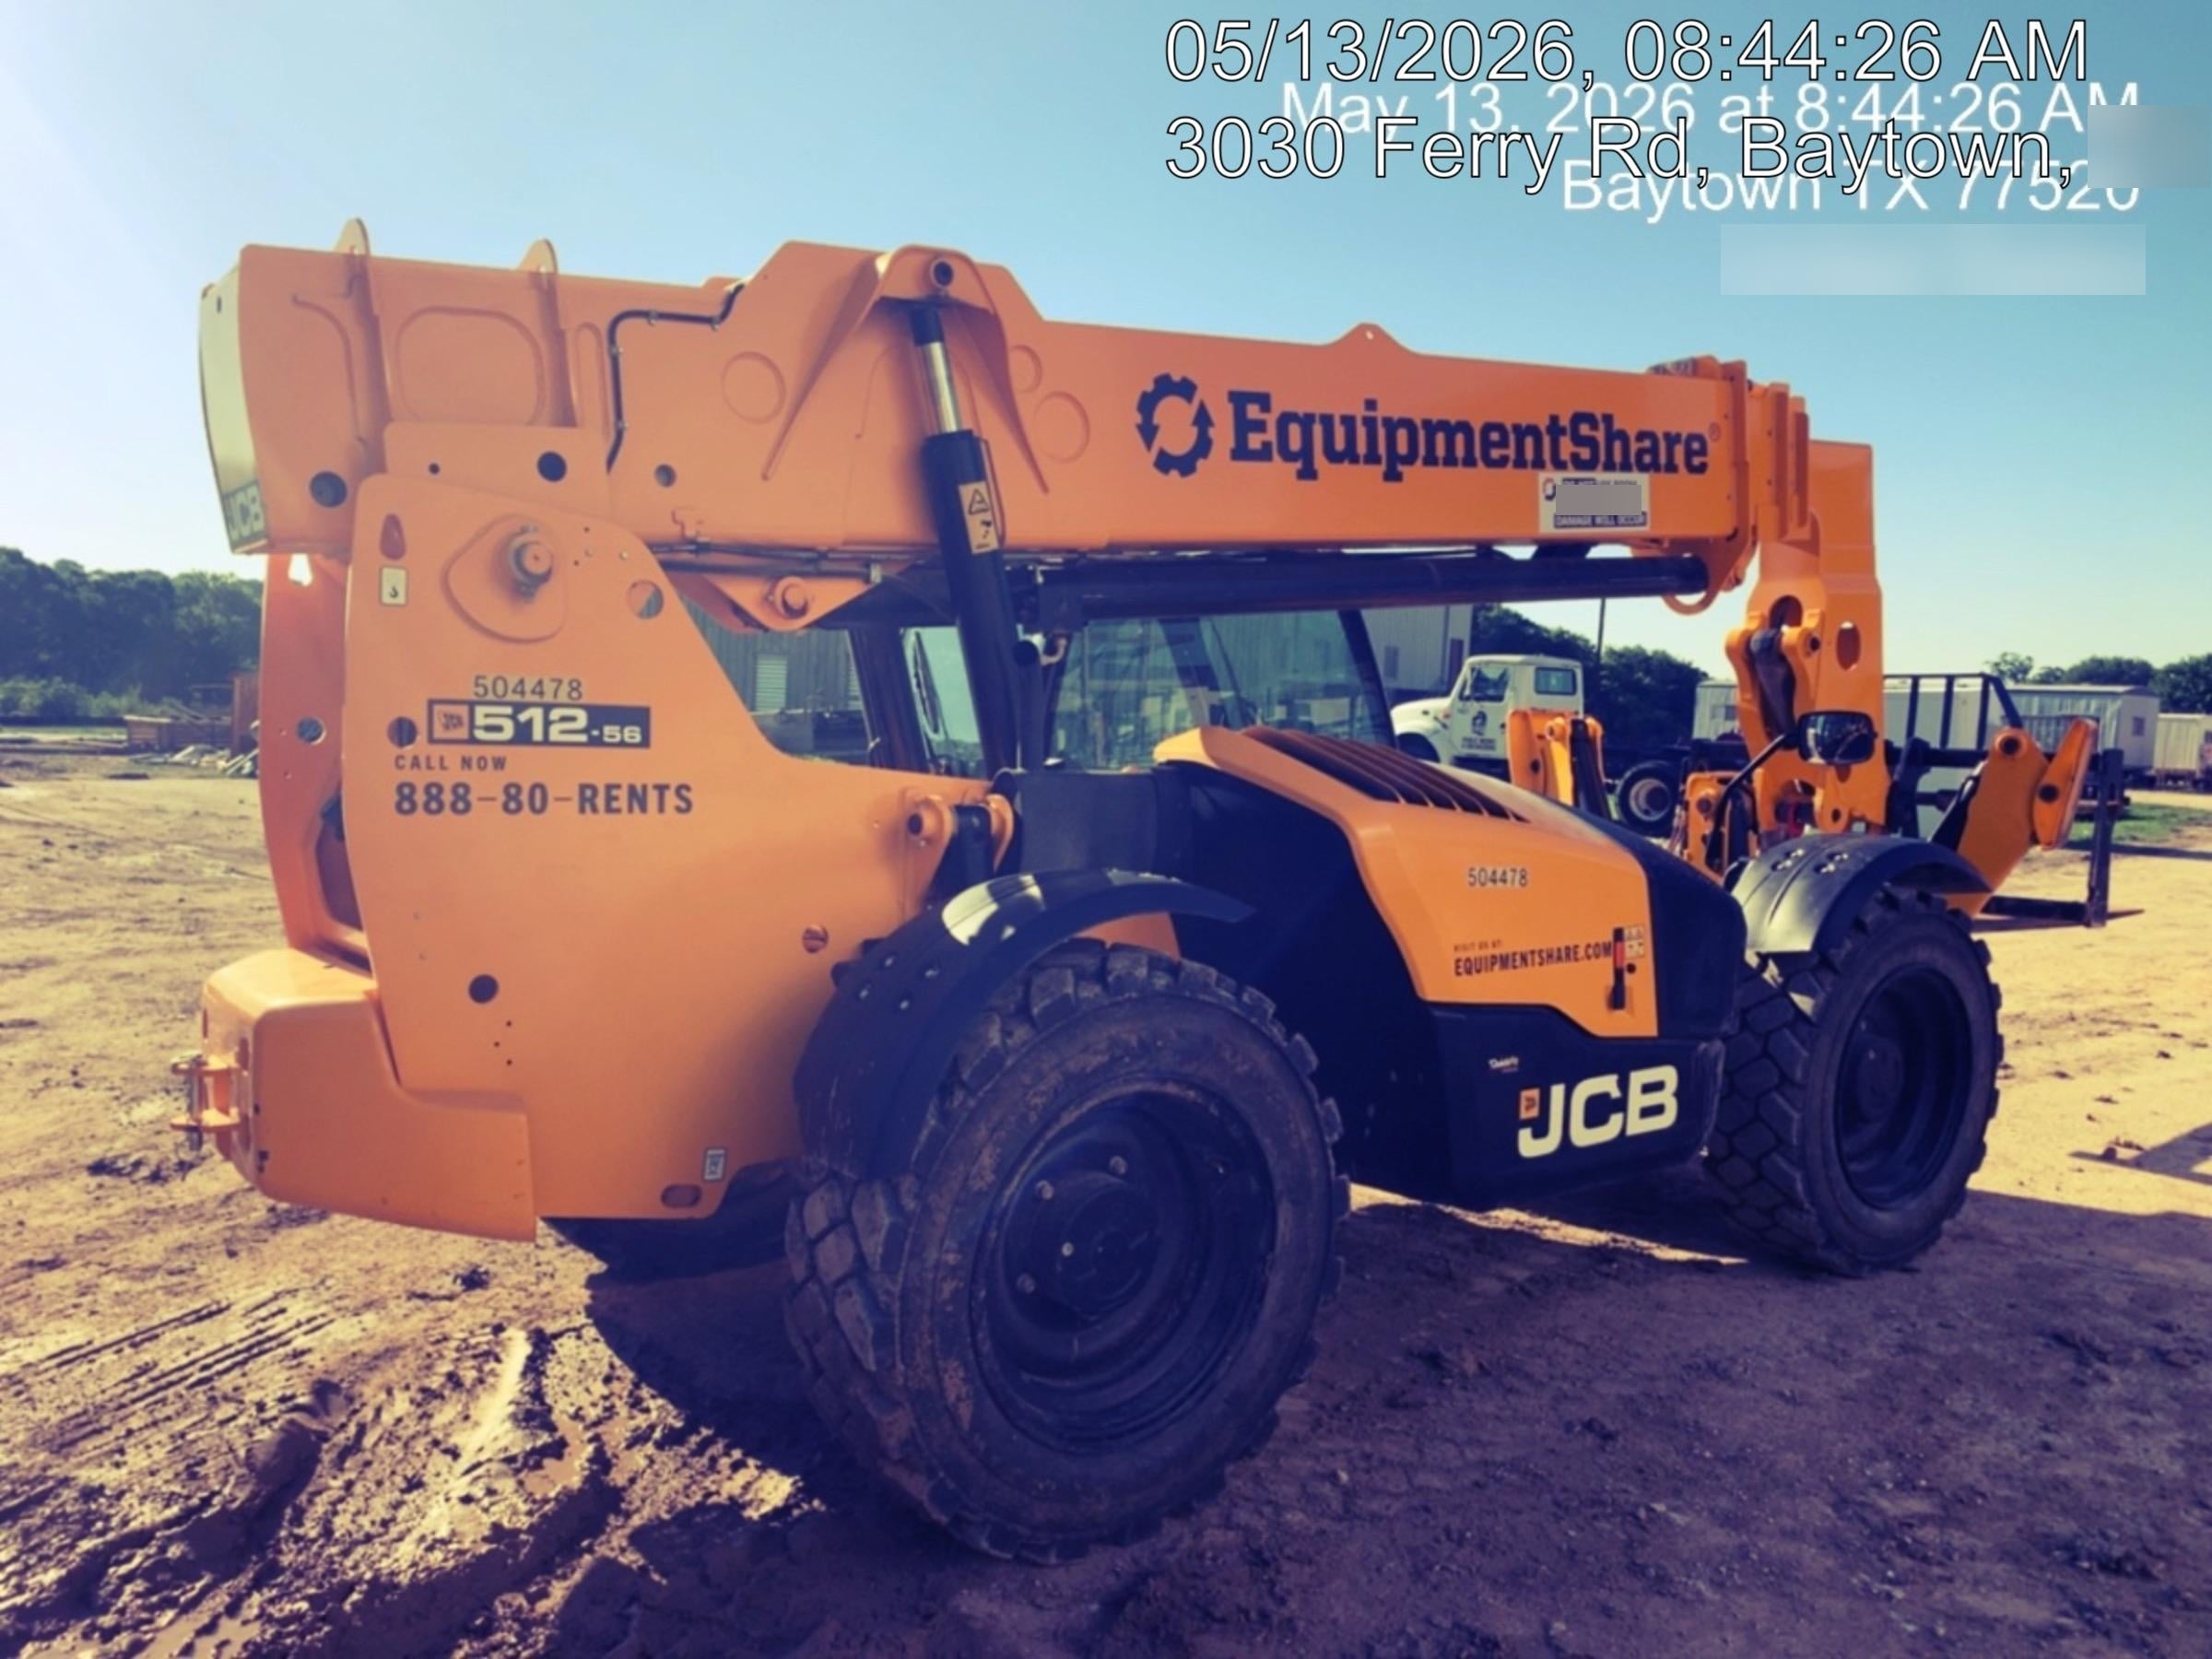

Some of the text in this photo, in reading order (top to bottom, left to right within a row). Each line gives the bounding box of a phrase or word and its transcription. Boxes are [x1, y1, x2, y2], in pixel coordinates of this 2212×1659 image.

[1228, 391, 1709, 481] EquipmentShare
[473, 675, 583, 701] 504478
[394, 755, 507, 771] CALL NOW
[394, 782, 693, 815] 888-80-RENTS
[1468, 867, 1528, 888] 504478
[1454, 941, 1613, 977] EQUIPMENTSHARE.COM
[1518, 1065, 1678, 1159] JCB
